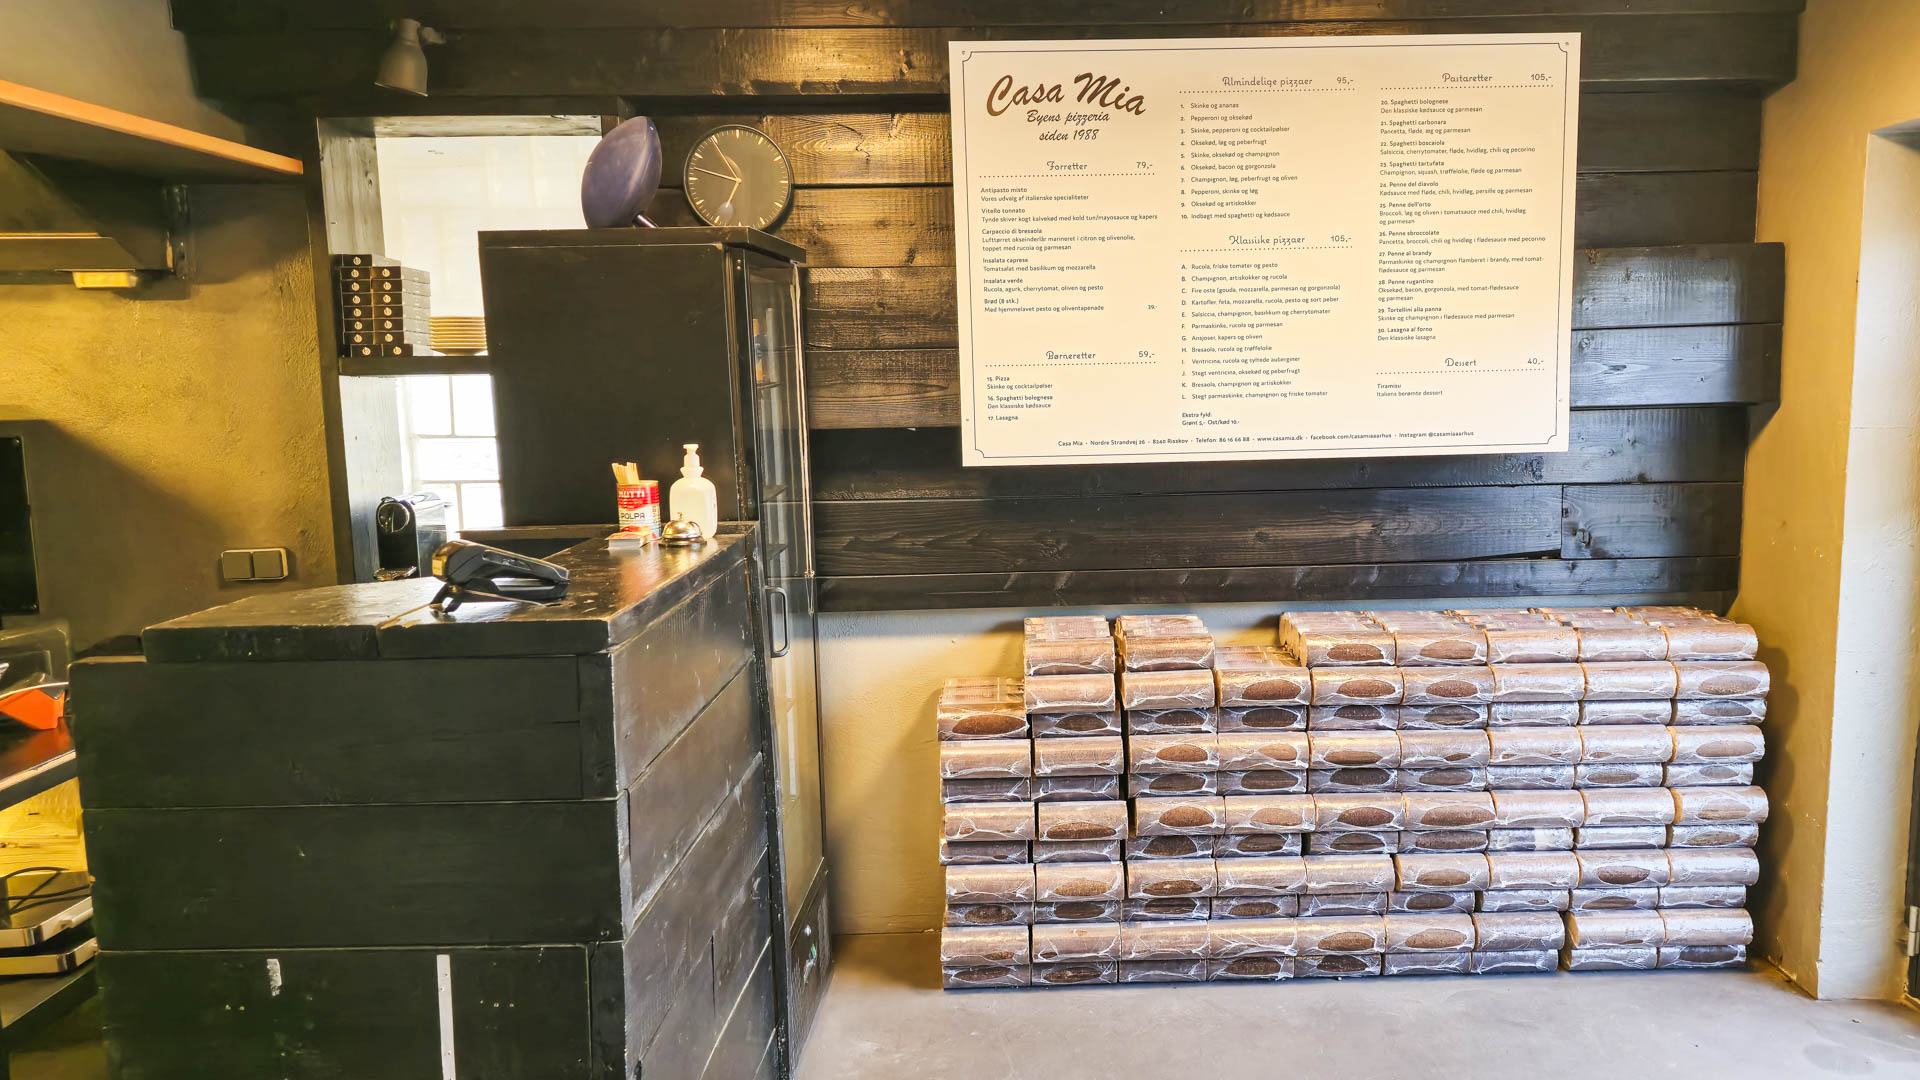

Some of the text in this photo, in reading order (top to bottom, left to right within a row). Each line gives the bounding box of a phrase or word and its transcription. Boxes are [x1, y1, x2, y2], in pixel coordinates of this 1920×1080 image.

[1222, 76, 1312, 88] Almindelige pizzaer
[1336, 76, 1353, 84] 95,-
[1441, 72, 1492, 82] Pastaretter
[986, 72, 1146, 117] Casa Mia
[1026, 109, 1110, 126] Byens pizzeria
[1039, 128, 1100, 141] siden 1988
[1046, 160, 1087, 170] Forretter
[1228, 234, 1305, 245] Klassiske pizzaer
[1330, 234, 1351, 242] 105,-
[1045, 350, 1095, 359] Børneretter
[1138, 350, 1154, 358] 59,-
[1444, 357, 1476, 366] Dessert
